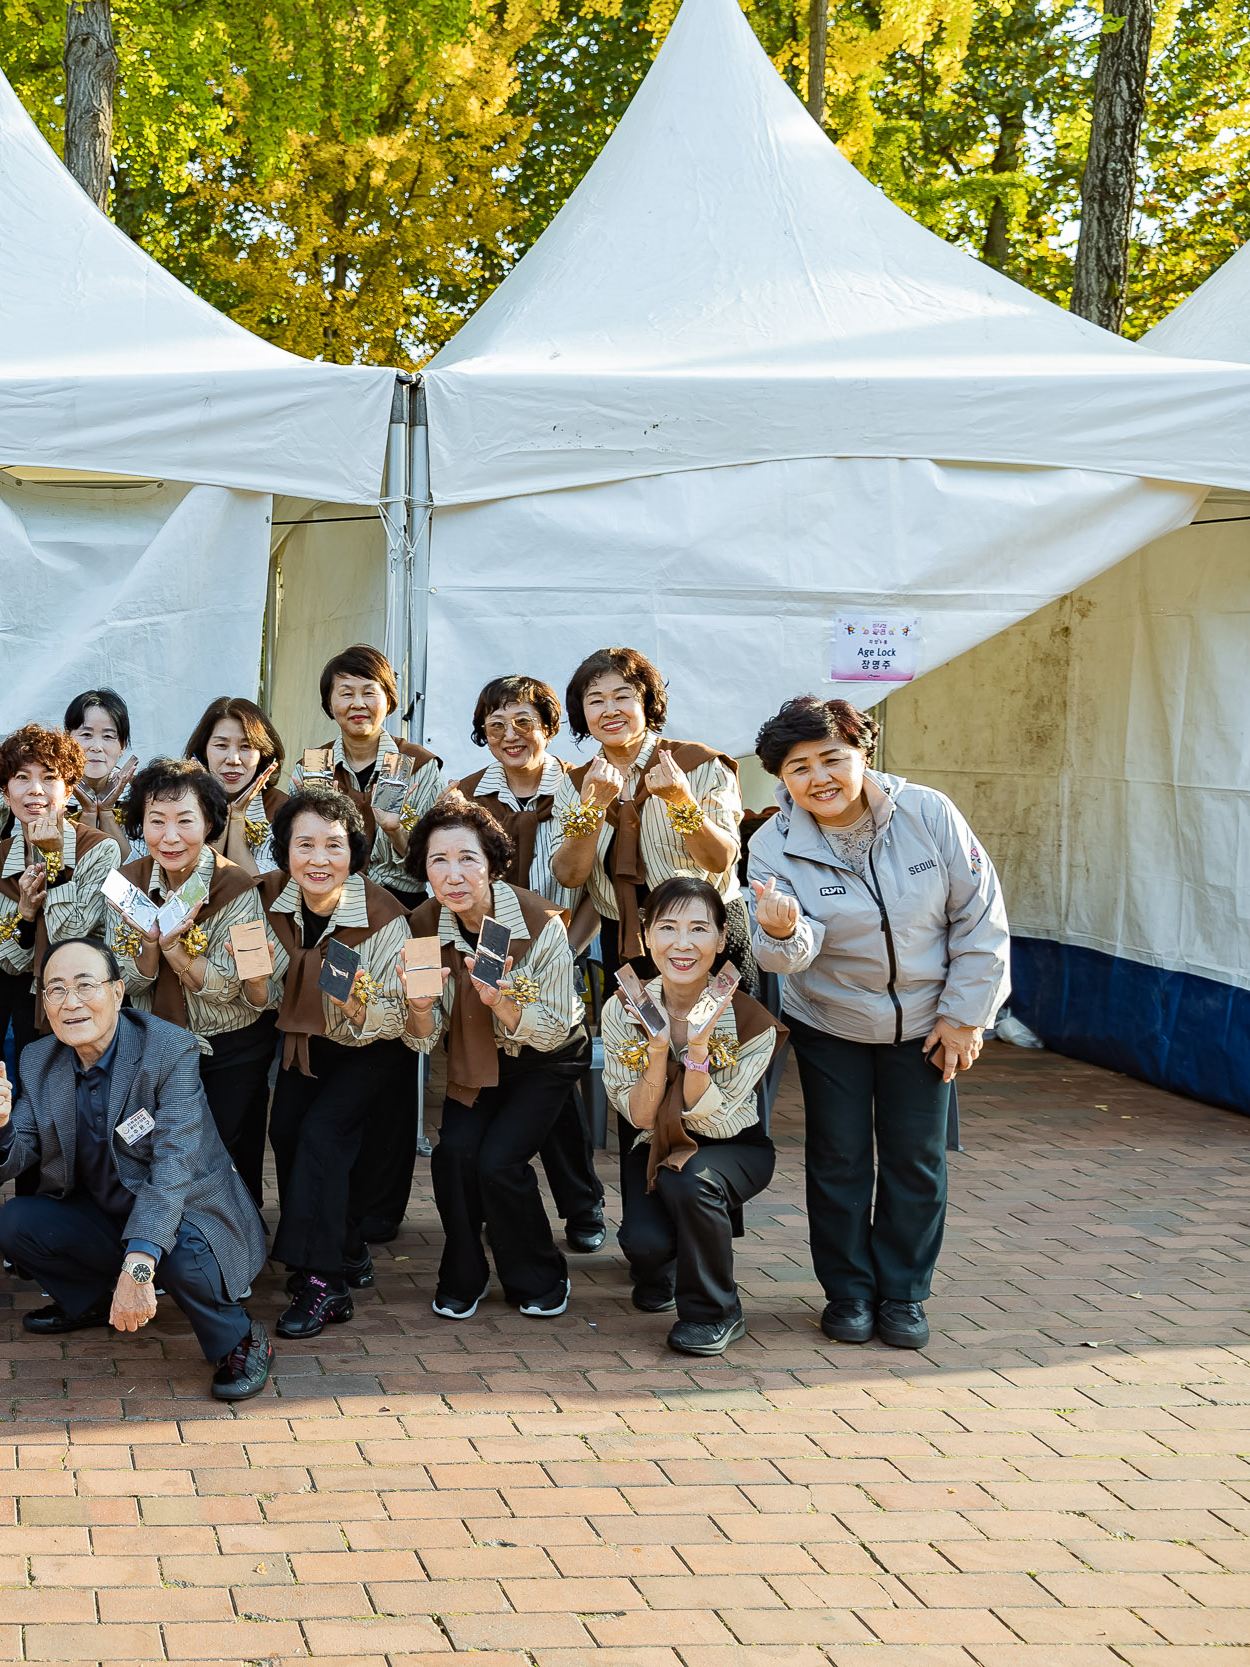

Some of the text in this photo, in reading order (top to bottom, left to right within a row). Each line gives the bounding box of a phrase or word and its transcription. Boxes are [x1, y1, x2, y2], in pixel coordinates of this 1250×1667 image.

[857, 647, 896, 658] Age Lock
[908, 859, 937, 876] SEOUL
